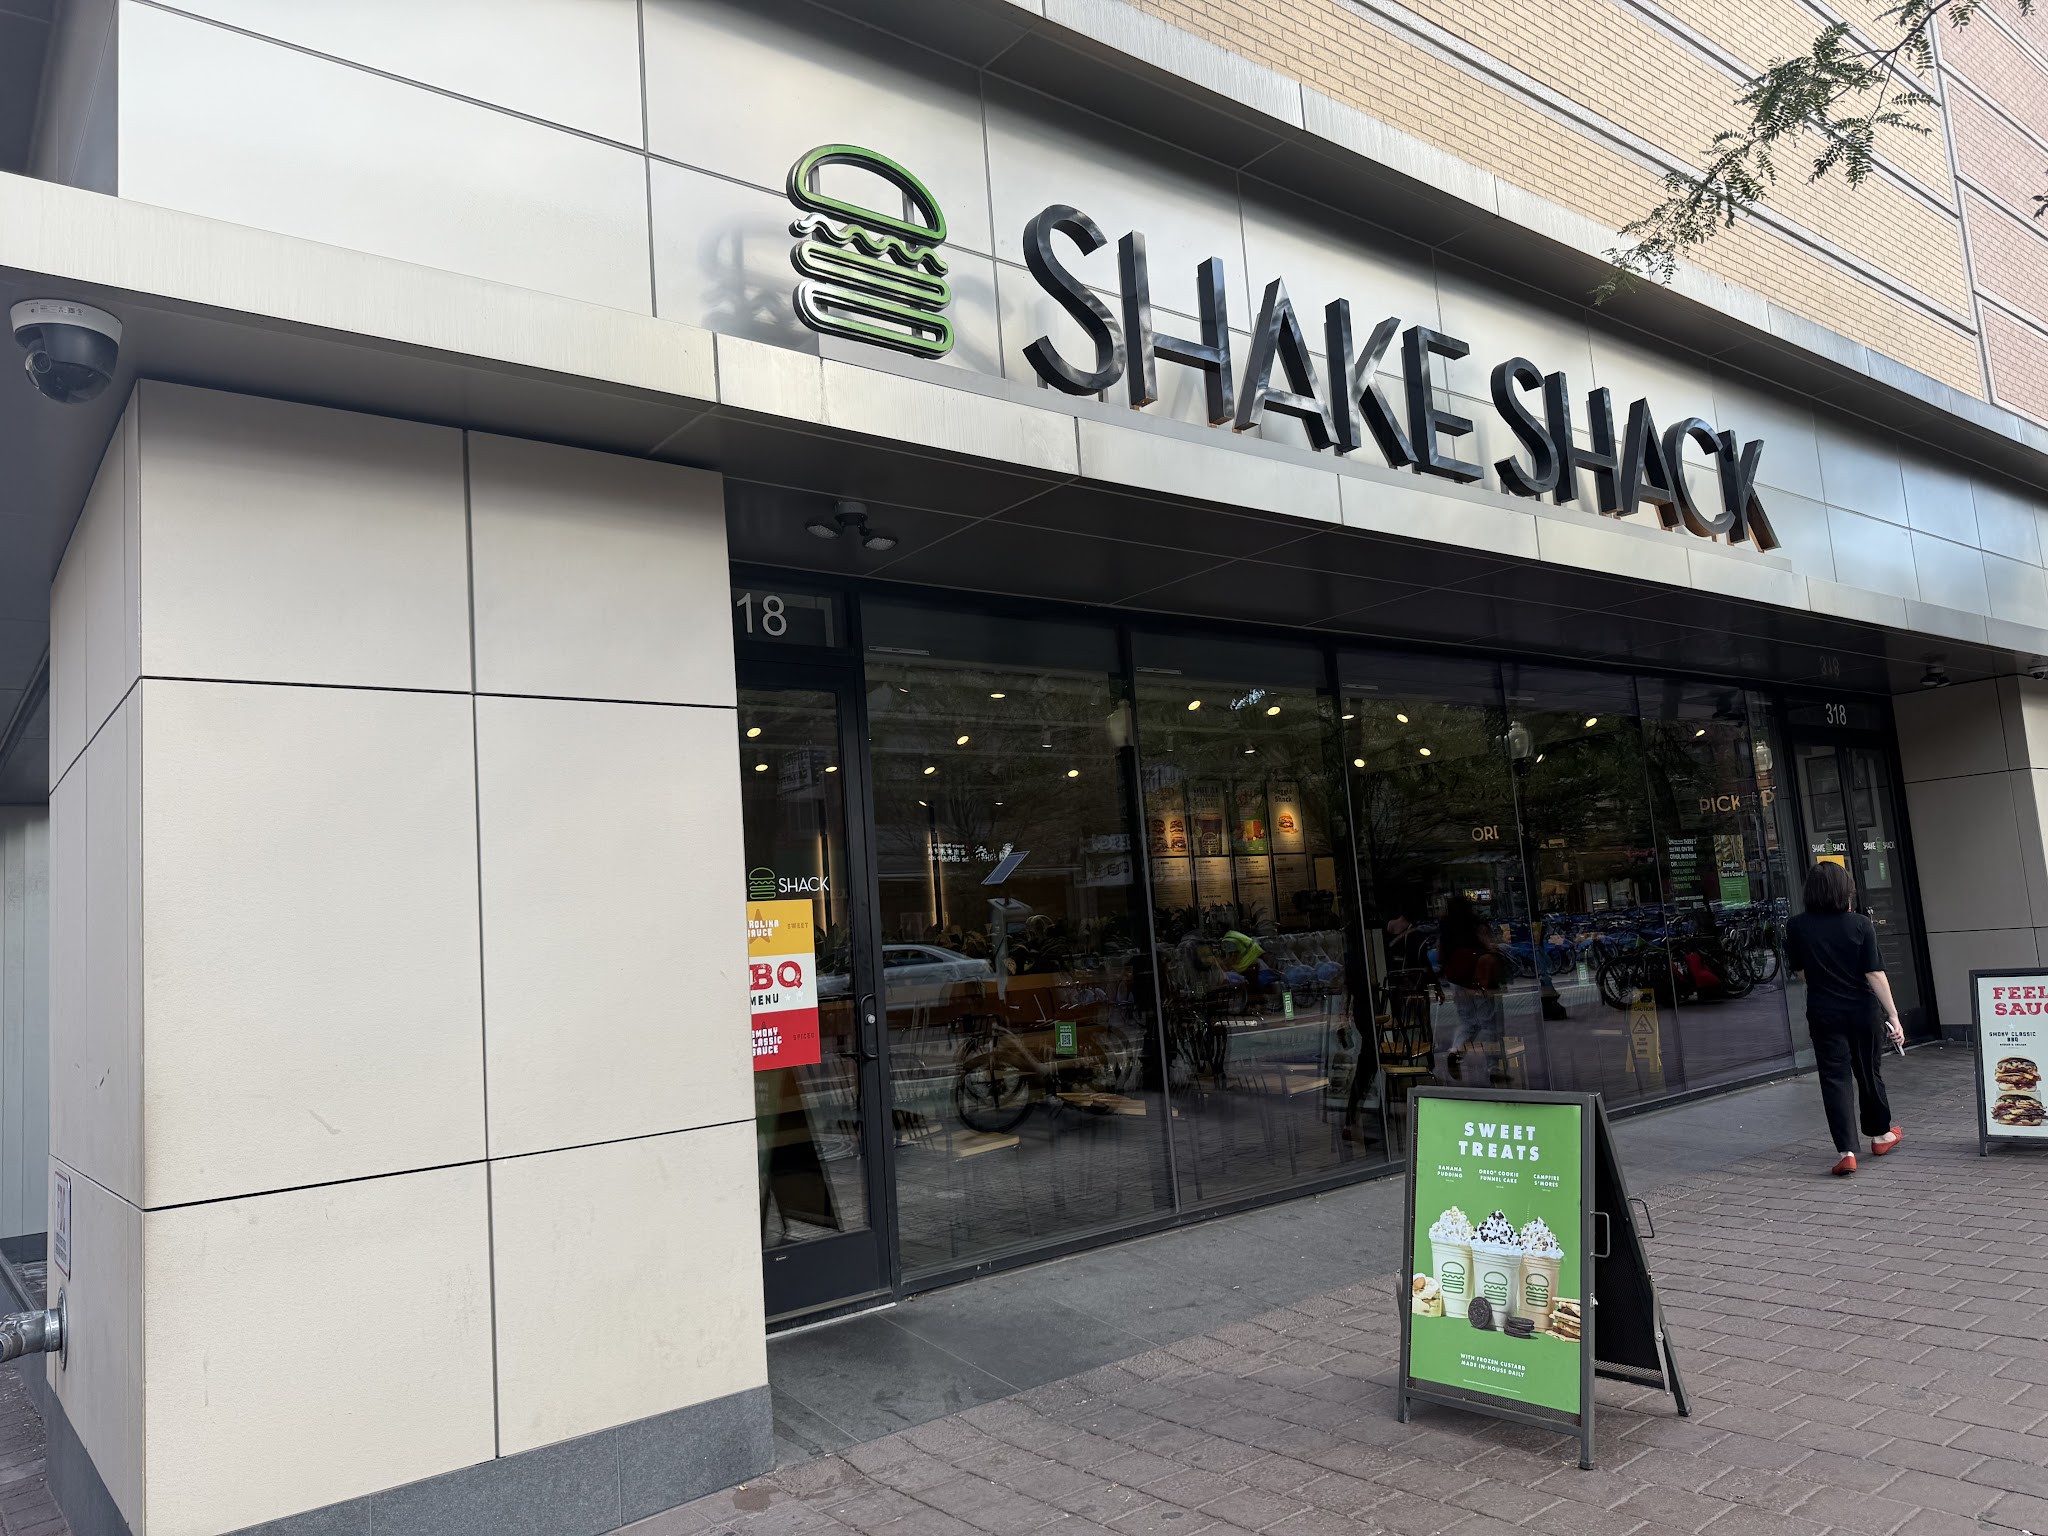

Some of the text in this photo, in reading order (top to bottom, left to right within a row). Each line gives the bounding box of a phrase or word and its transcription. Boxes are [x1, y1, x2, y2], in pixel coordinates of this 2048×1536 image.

[1022, 204, 1782, 553] SHAKE SHACK
[736, 592, 787, 636] 18
[1825, 703, 1847, 725] 318
[1699, 795, 1740, 814] PICK
[1833, 842, 1846, 852] SHACK
[778, 876, 829, 893] SHACK
[748, 920, 779, 929] ROLINA
[787, 922, 808, 930] SWEET
[749, 960, 803, 991] BQ
[750, 993, 779, 1006] MENU
[1992, 985, 2048, 1000] FEEL
[752, 1036, 782, 1048] LASSIC
[1464, 1122, 1536, 1141] SWEET
[1458, 1140, 1540, 1162] TREATS
[1498, 1170, 1519, 1178] COOKIE
[1460, 1353, 1526, 1371] WITH FROZEN CUSTARD
[1461, 1360, 1525, 1378] MADE IN-HOUSE DAILY
